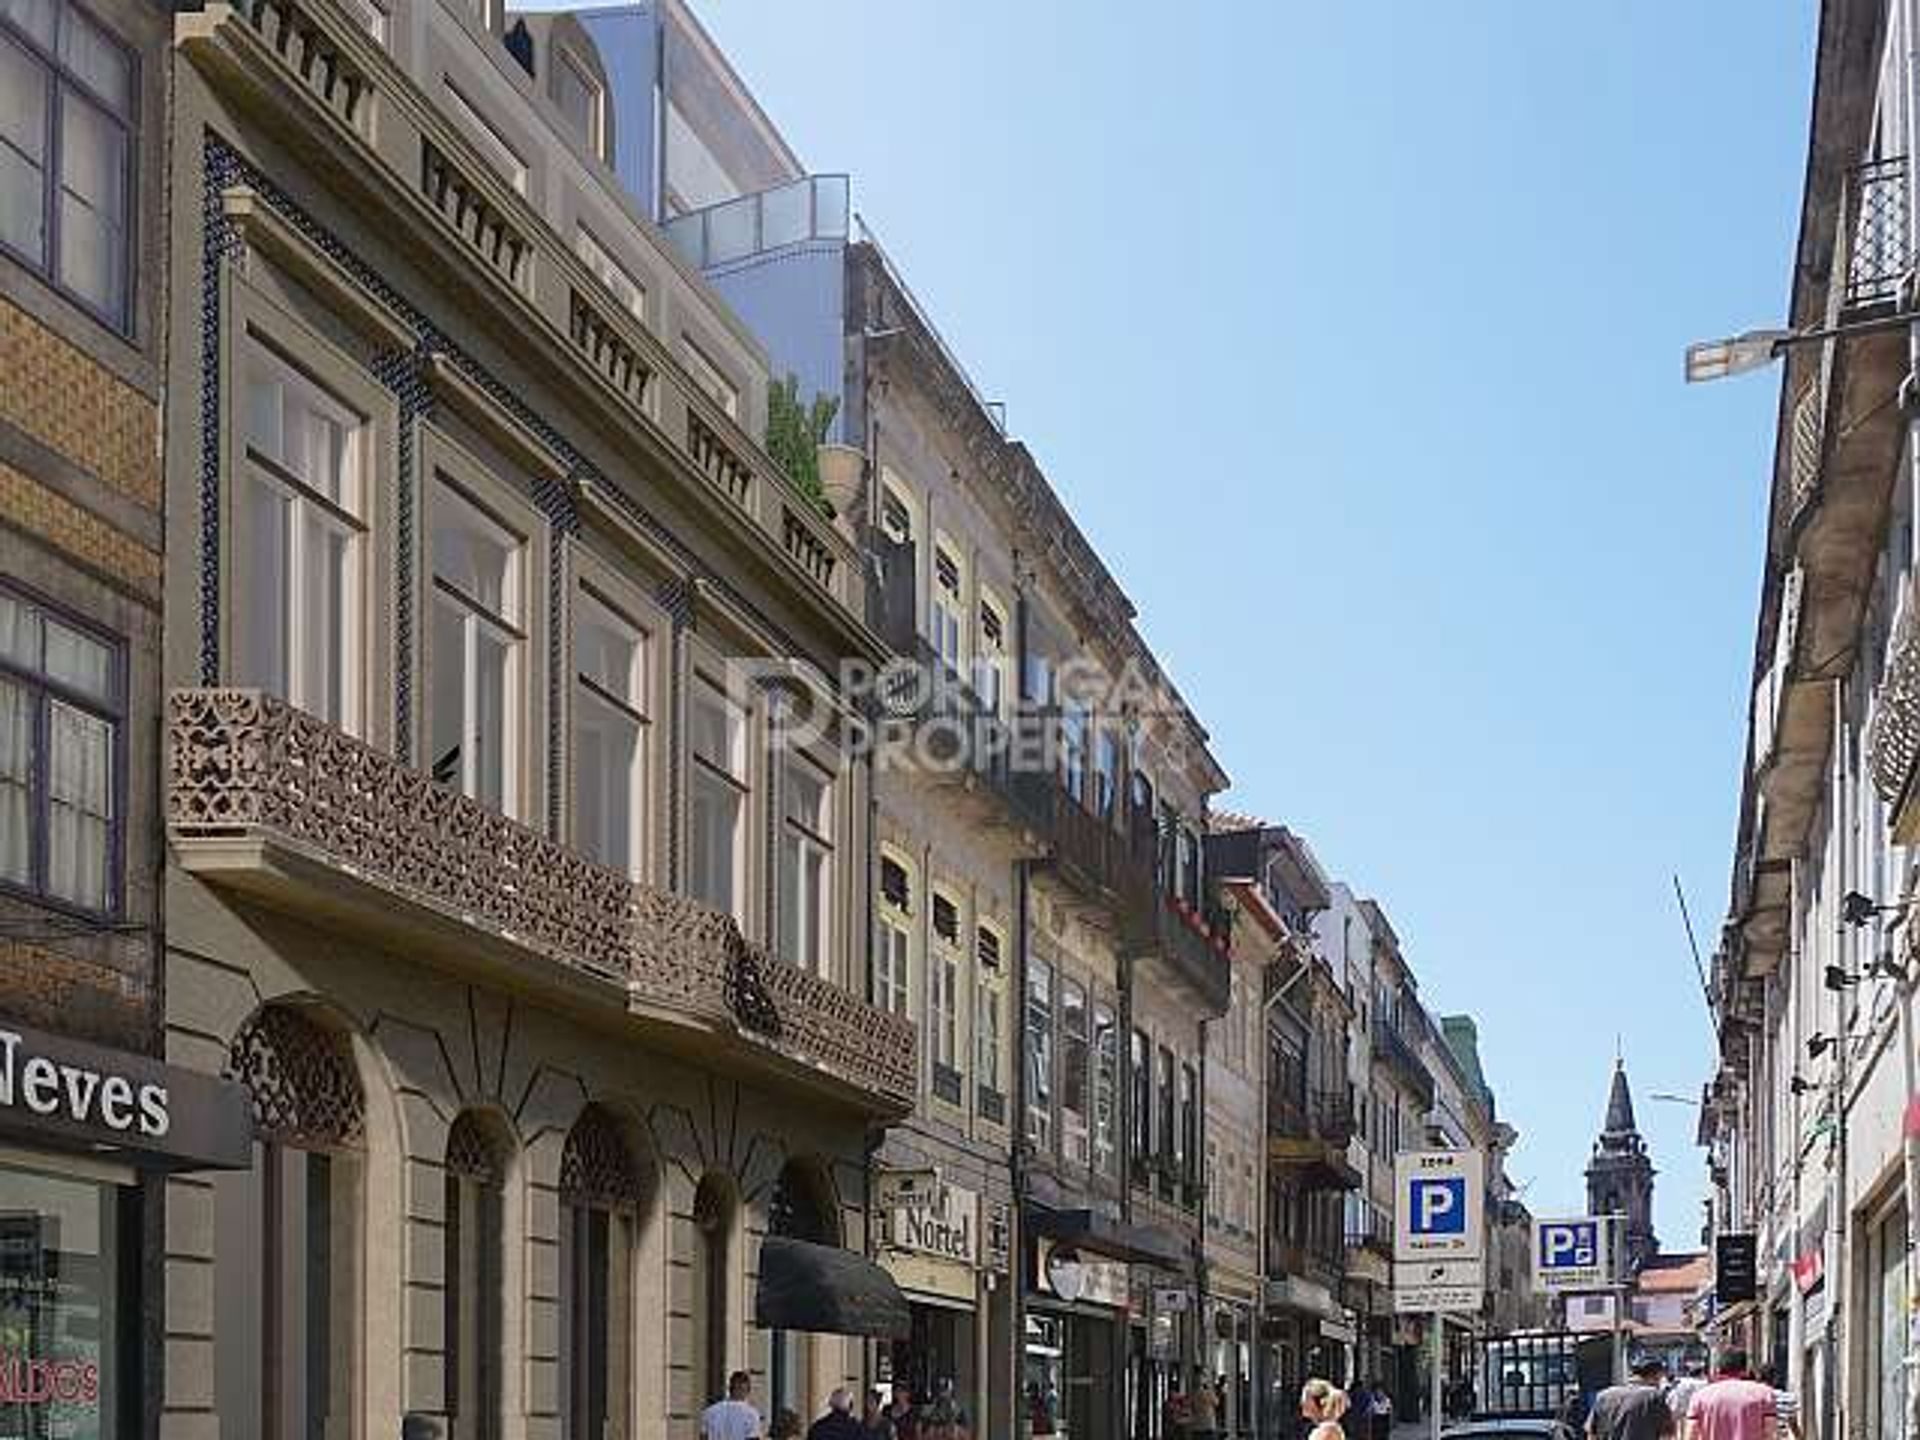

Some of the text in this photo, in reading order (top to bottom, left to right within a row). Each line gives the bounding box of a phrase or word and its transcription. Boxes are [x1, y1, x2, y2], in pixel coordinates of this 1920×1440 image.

[1421, 1185, 1453, 1230] P
[905, 1207, 970, 1258] Nortel
[1546, 1227, 1575, 1264] P
